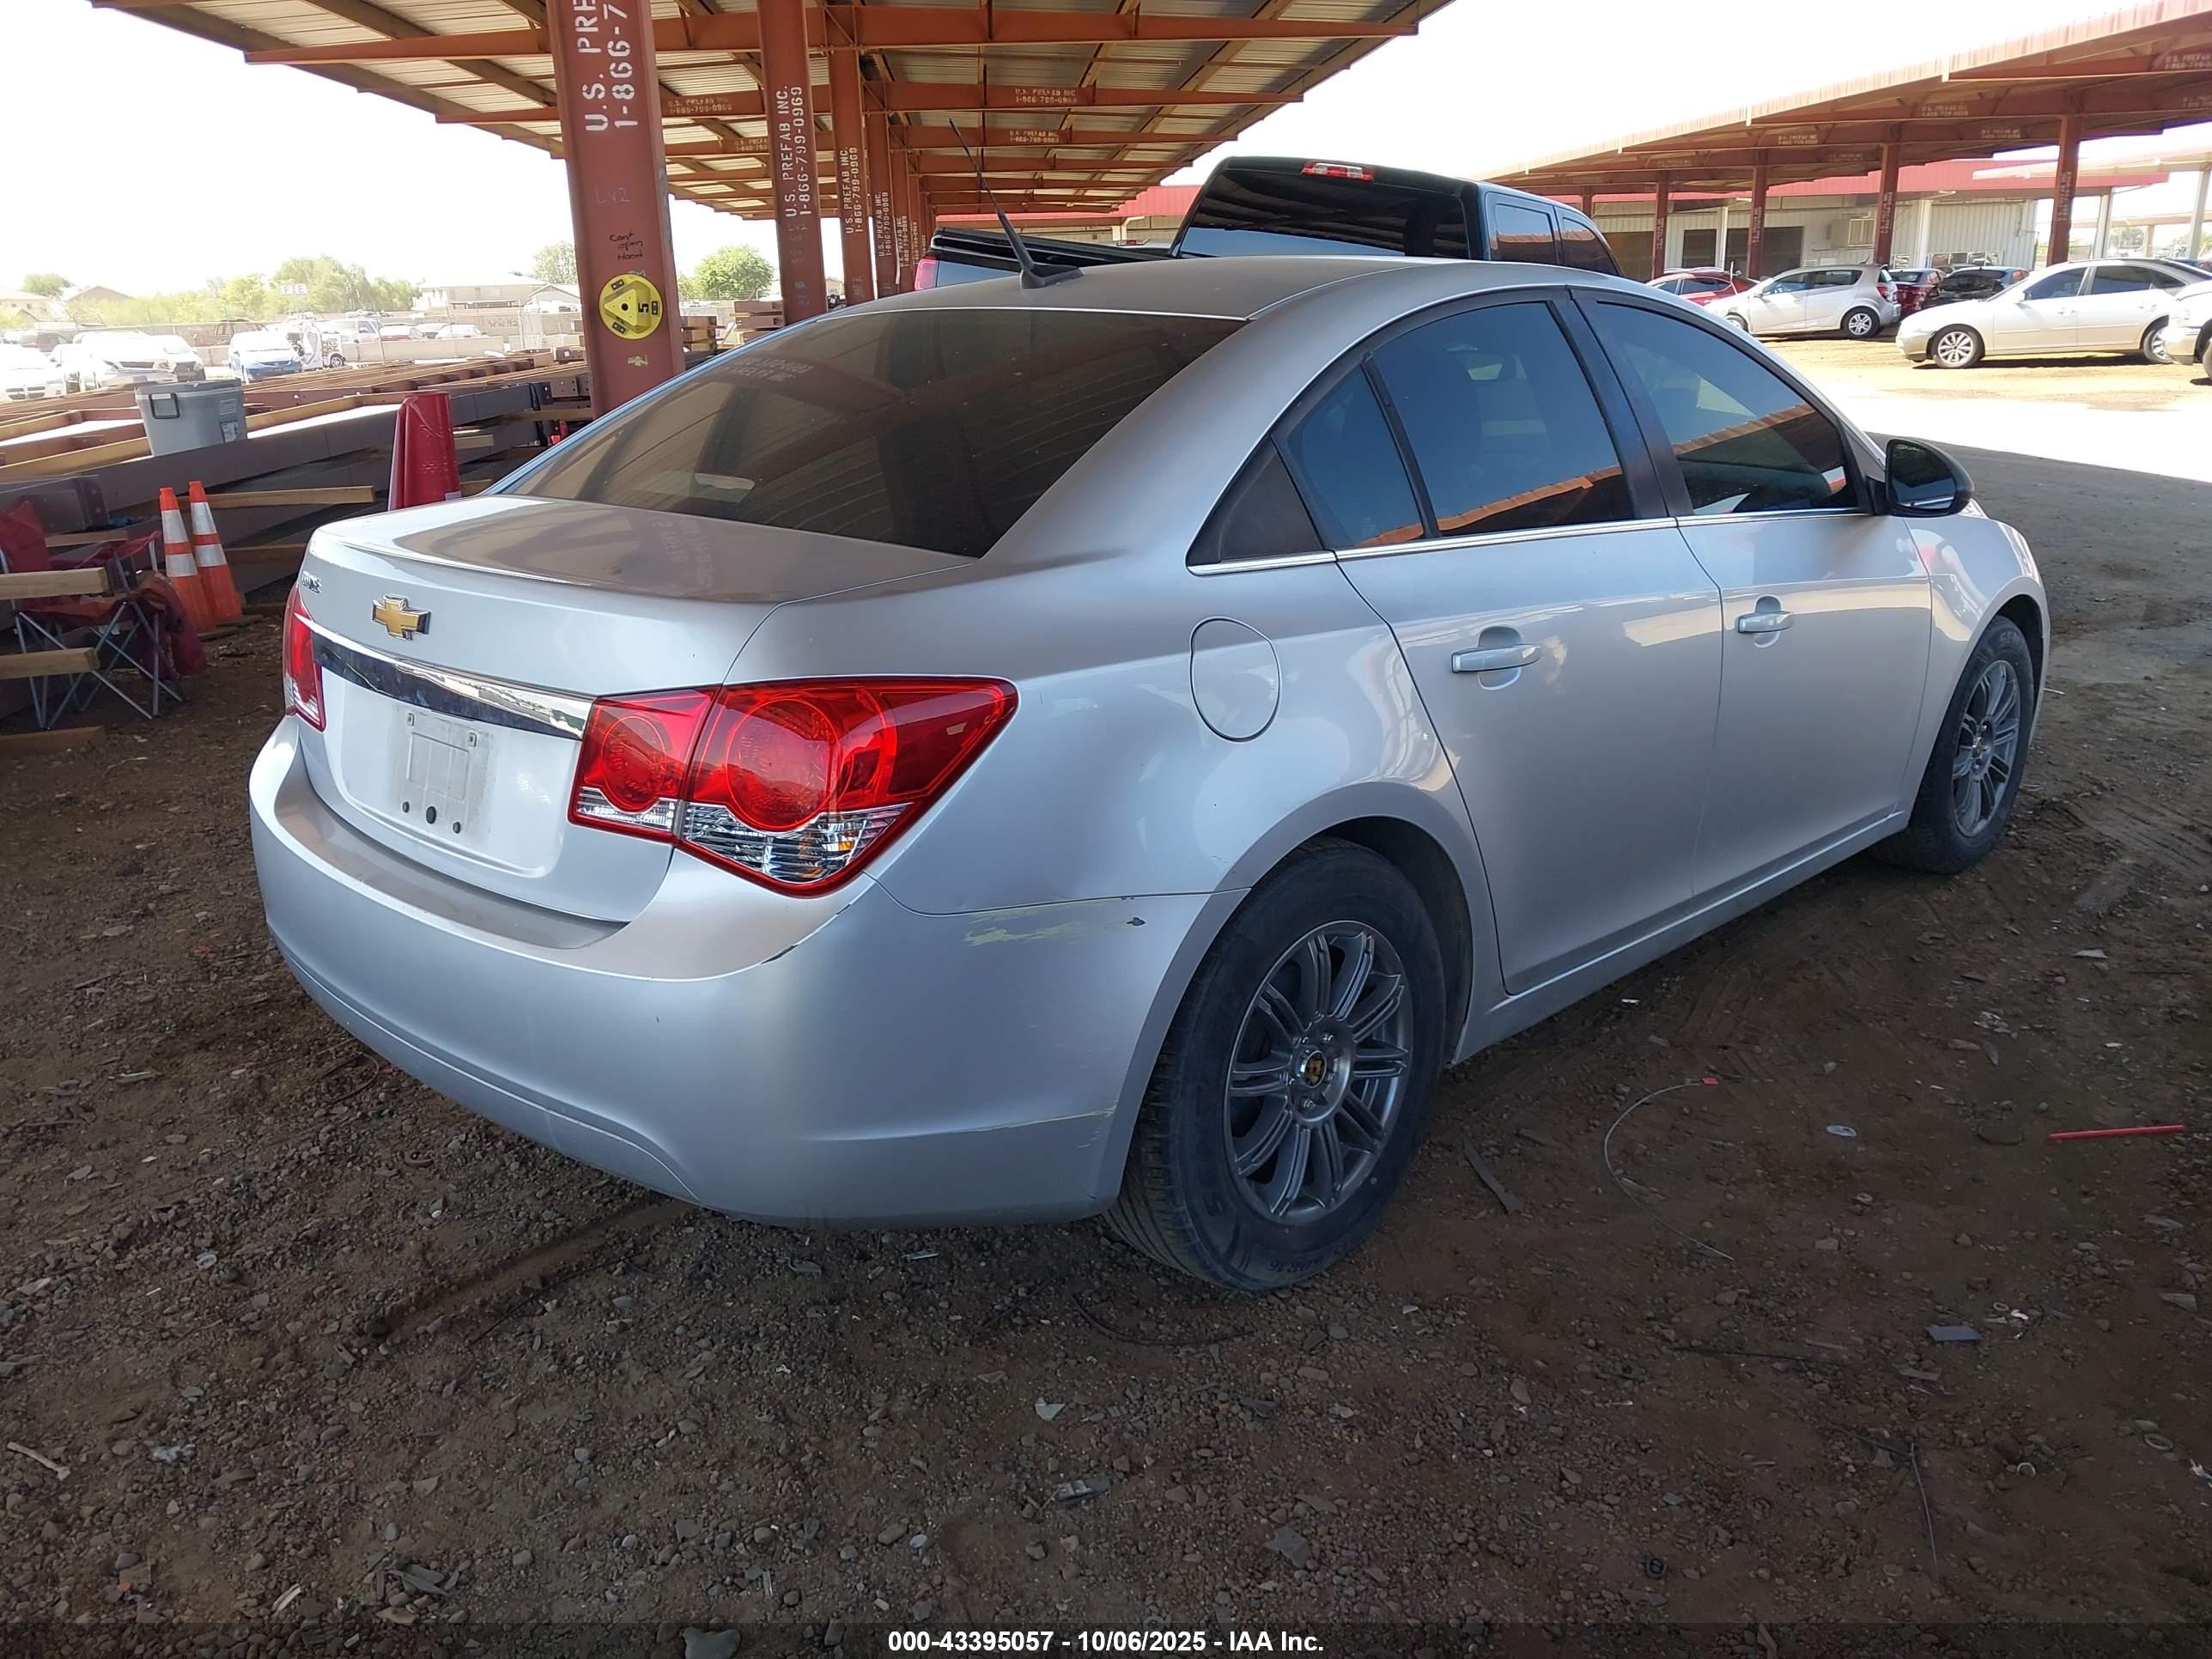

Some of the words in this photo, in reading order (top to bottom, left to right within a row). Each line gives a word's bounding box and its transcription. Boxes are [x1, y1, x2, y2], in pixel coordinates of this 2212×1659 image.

[603, 3, 638, 127] 1-866-7
[581, 74, 609, 131] U.S.
[776, 86, 790, 114] INC.
[779, 123, 793, 180] PREFAB
[791, 87, 811, 215] 1-866-799-0969
[785, 189, 798, 217] U.S.
[842, 170, 853, 210] PREFAB
